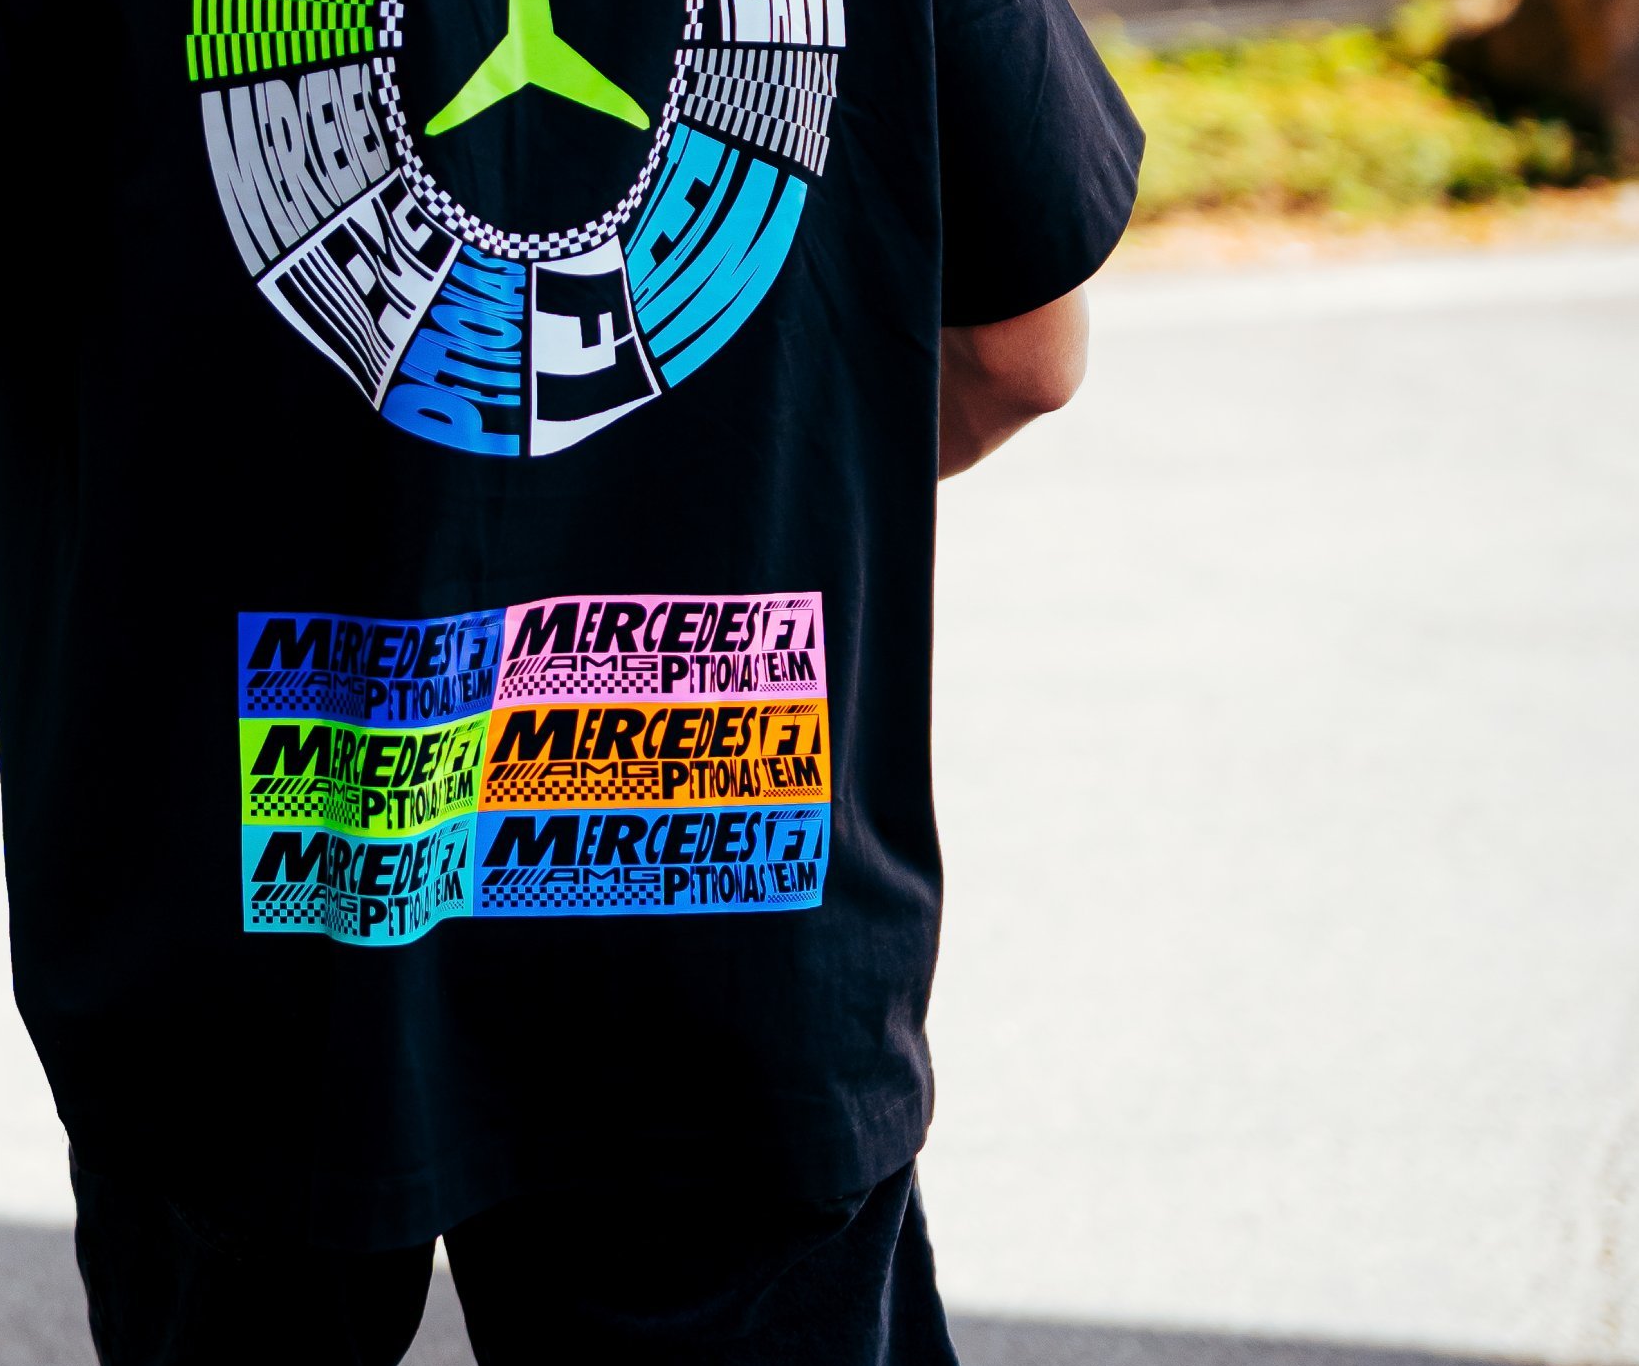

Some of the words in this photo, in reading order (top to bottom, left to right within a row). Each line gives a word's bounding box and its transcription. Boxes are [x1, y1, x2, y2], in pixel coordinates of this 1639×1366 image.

[201, 63, 390, 277] MERCEDES
[381, 243, 527, 456] PETRONAS
[625, 122, 807, 388] TEAM
[247, 618, 456, 678] MERCEDES
[458, 624, 502, 671] F1
[506, 602, 761, 661] MERCEDES
[762, 609, 816, 650] F1
[305, 670, 364, 695] AMG
[364, 677, 457, 721] PETRONAS
[542, 655, 659, 672] AMG
[661, 654, 759, 693] PETRONAS
[761, 651, 817, 682] TEAM
[250, 724, 453, 788] MERCEDES
[445, 727, 484, 776] F1
[490, 706, 757, 763] MERCEDES
[761, 714, 822, 756] F1
[305, 778, 360, 804] AMG
[540, 761, 659, 779] AMG
[661, 759, 761, 800] PETRONAS
[762, 756, 822, 789] TEAM
[251, 831, 437, 896] MERCEDES
[481, 811, 762, 867] MERCEDES
[765, 819, 823, 862] F1
[543, 867, 661, 885] AMG
[663, 864, 766, 905] PETRONAS
[767, 861, 818, 892] TEAM
